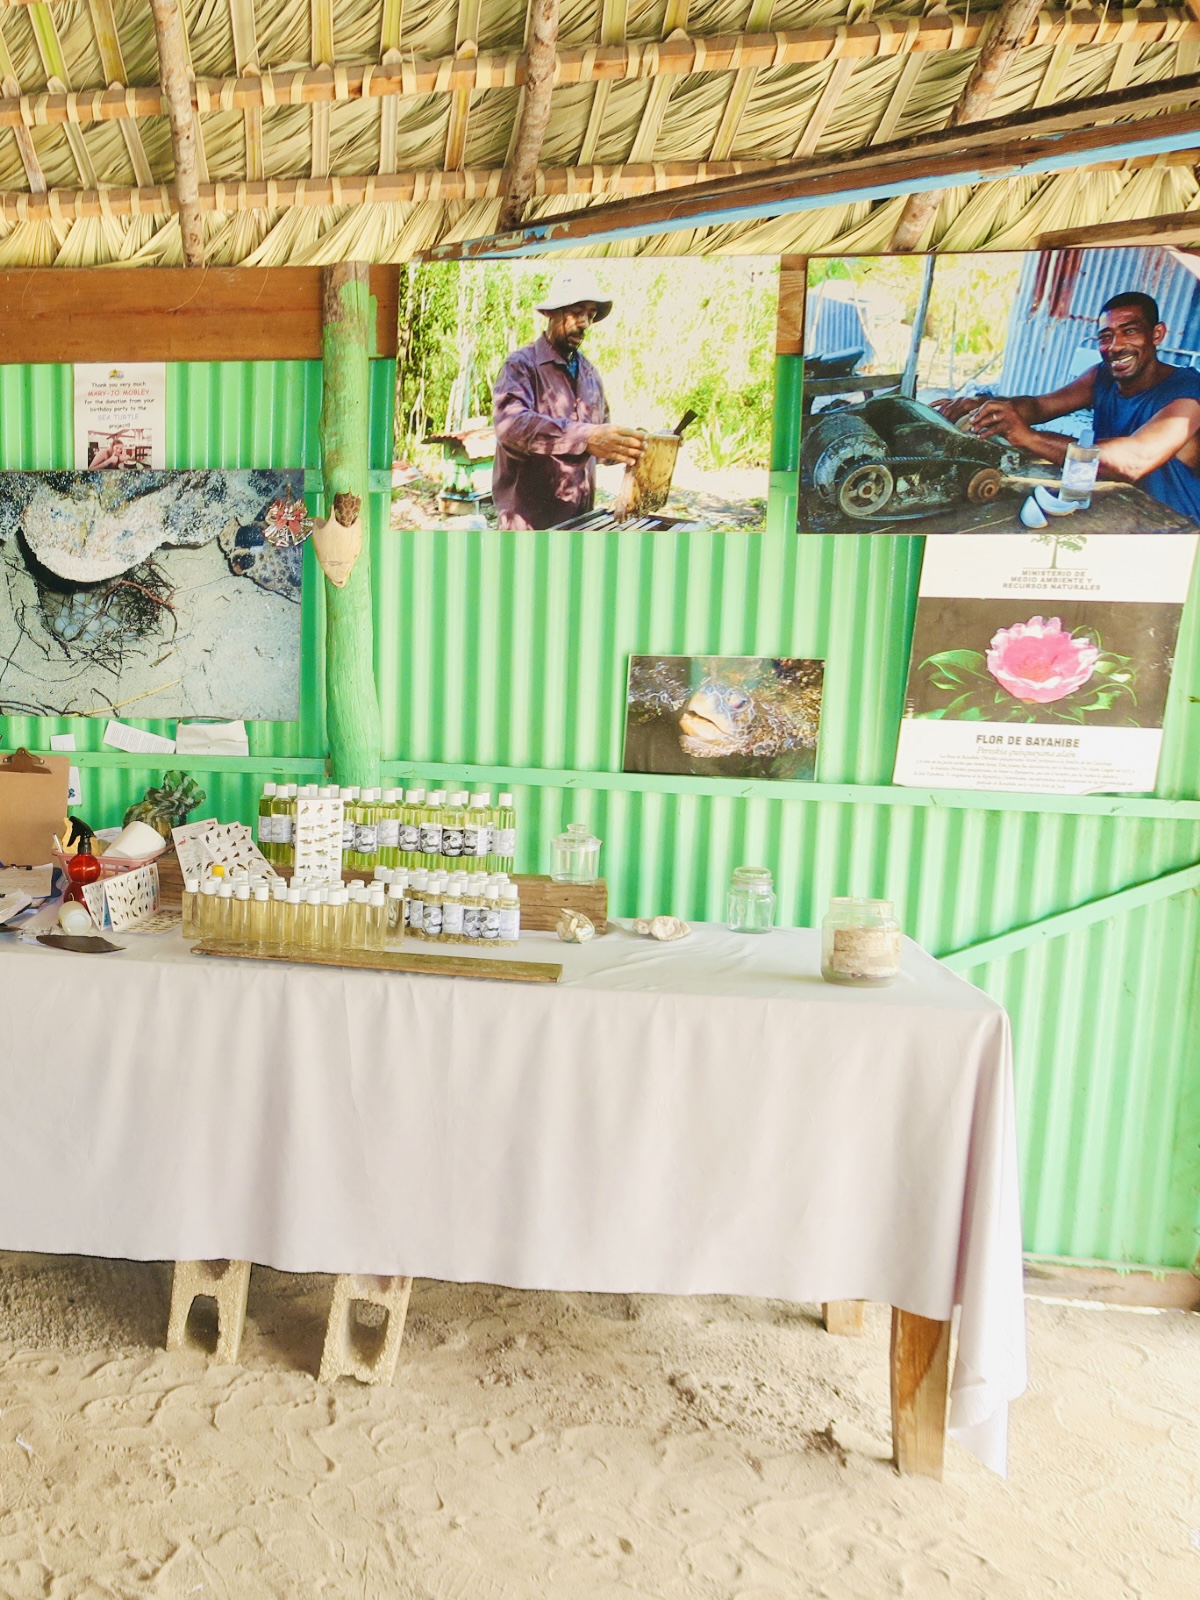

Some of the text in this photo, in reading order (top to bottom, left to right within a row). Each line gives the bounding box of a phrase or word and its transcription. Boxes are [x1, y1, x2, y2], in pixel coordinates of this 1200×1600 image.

[1021, 569, 1072, 577] MINISTERIO
[1050, 583, 1100, 591] NATURALES
[976, 734, 1080, 748] FLOR DE BAYAHIBE
